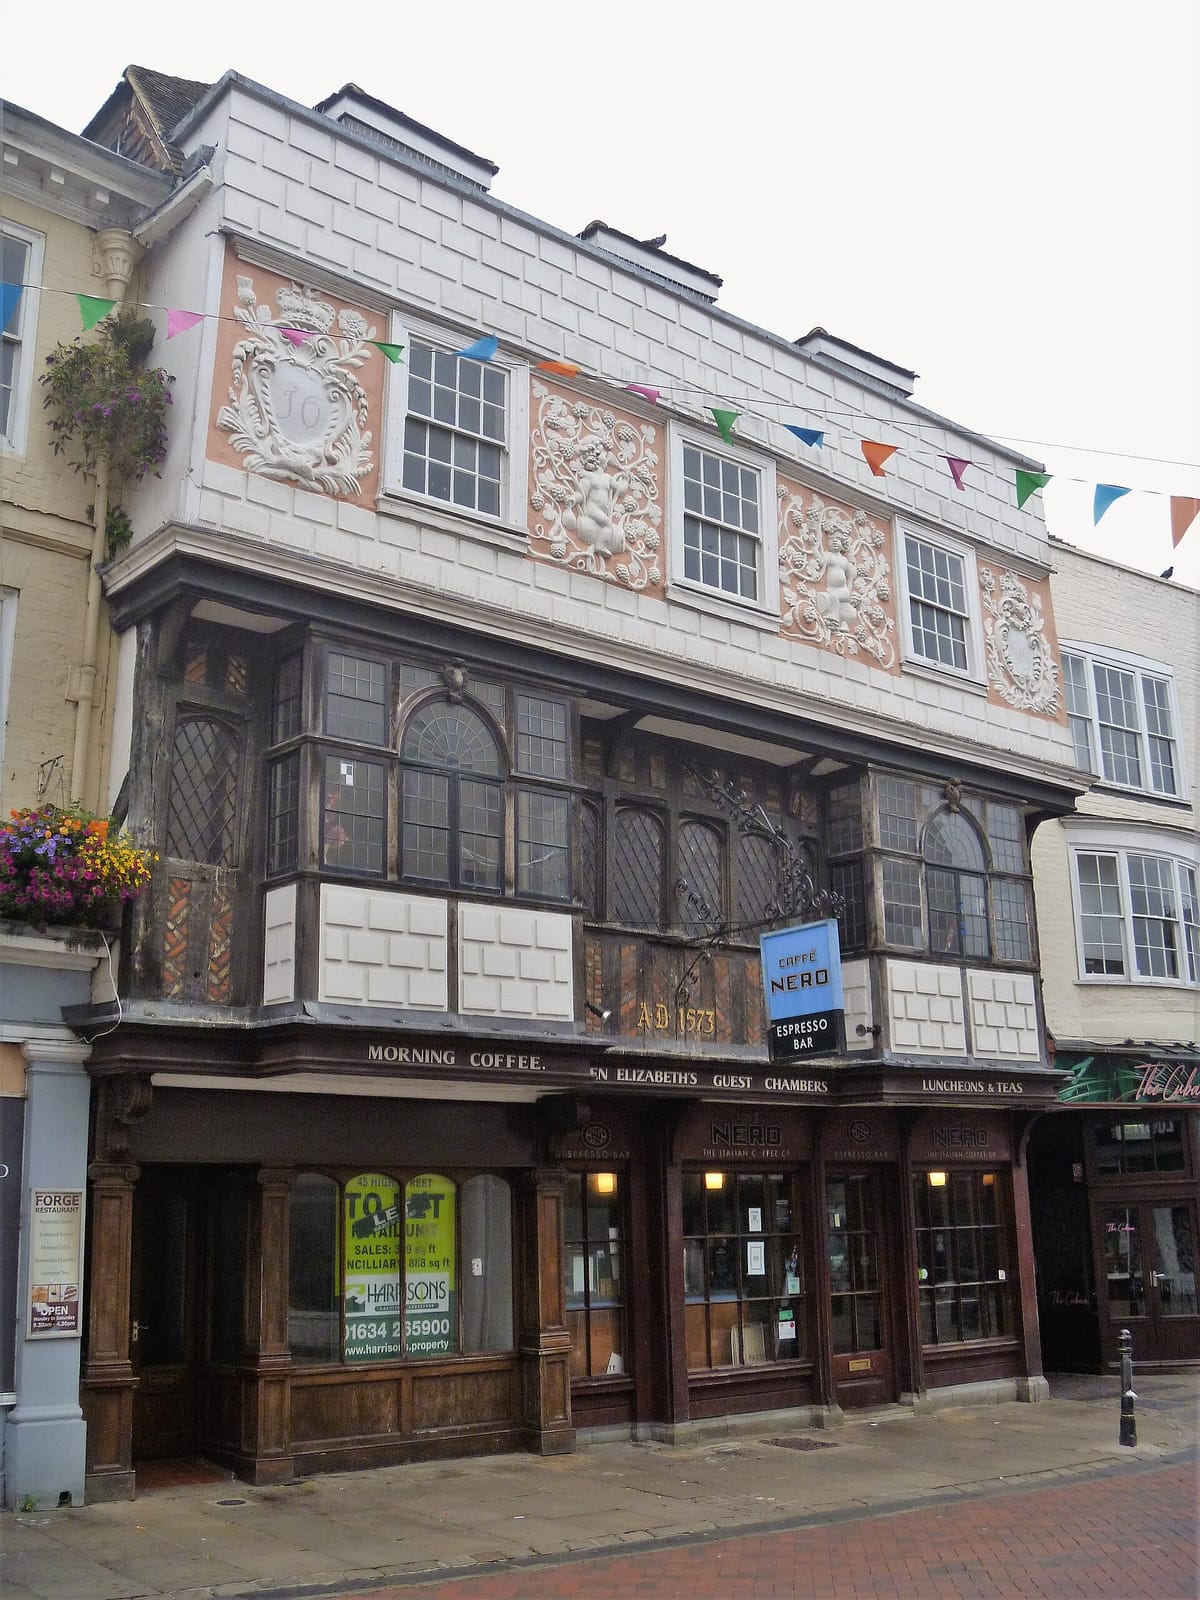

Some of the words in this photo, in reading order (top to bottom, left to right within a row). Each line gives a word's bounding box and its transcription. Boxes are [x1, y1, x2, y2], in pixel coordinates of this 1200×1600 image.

[770, 969, 828, 994] NERO
[679, 1008, 714, 1034] 1573
[776, 1018, 828, 1038] ESPRESSO
[793, 1037, 814, 1050] BAR
[368, 1045, 456, 1065] MORNING
[470, 1052, 546, 1071] COFFEE.
[713, 1074, 752, 1089] GUEST
[764, 1077, 829, 1093] CHAMBERS
[922, 1079, 984, 1093] LUNCHEONS
[988, 1083, 995, 1093] &
[995, 1081, 1023, 1094] TEAS
[711, 1122, 782, 1147] NERO
[932, 1125, 988, 1148] NERO
[751, 1150, 778, 1158] CFFEE
[35, 1195, 80, 1206] FORGE
[35, 1206, 80, 1214] RESTAURANT
[345, 1193, 382, 1219] TO
[354, 1244, 391, 1255] SALES:
[428, 1243, 436, 1253] ft
[429, 1260, 440, 1269] sq
[442, 1257, 450, 1267] ft
[367, 1281, 447, 1303] HARSONS
[41, 1305, 69, 1316] OPEN
